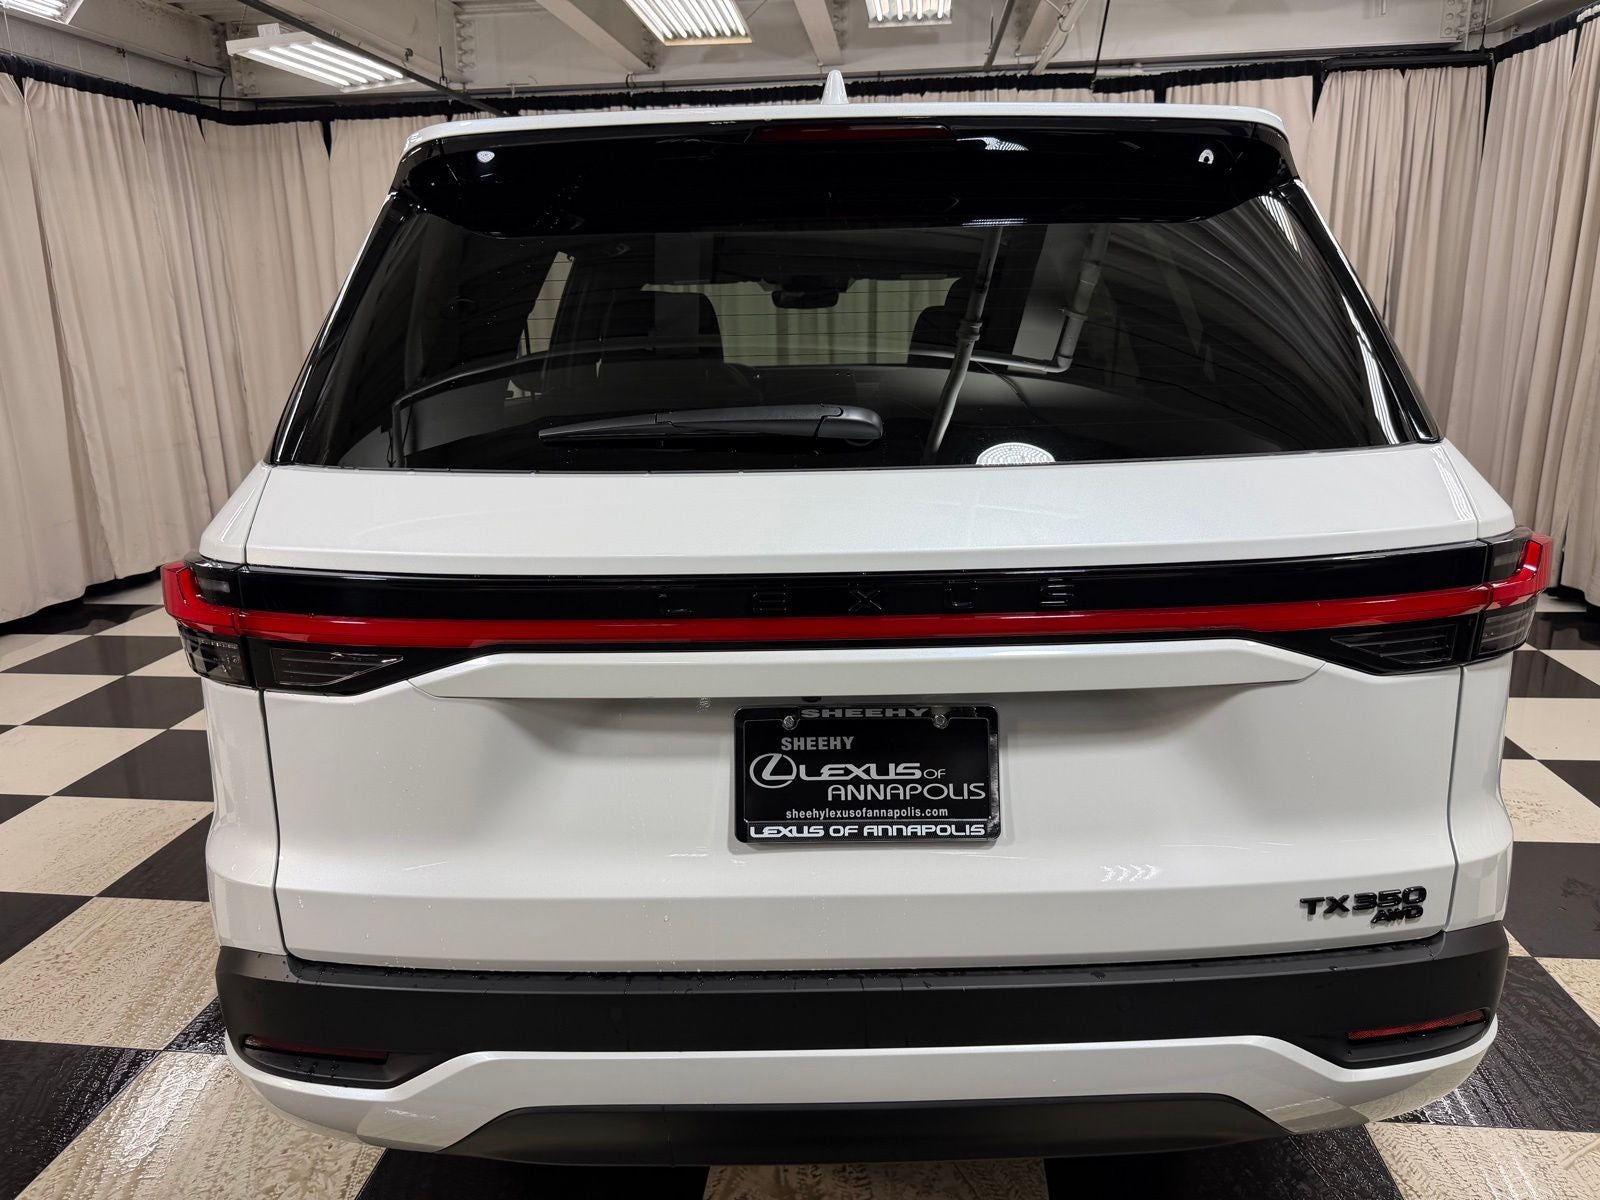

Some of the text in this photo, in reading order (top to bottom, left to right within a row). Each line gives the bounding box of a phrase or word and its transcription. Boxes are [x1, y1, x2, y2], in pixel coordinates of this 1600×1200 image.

[801, 708, 929, 718] SHEEHY
[781, 736, 854, 751] SHEEHY
[800, 763, 946, 780] LEXUS OF
[828, 783, 986, 801] ANNAPOLIS
[786, 807, 948, 820] sheehylexusofannapolis.com
[750, 824, 985, 838] LEXUS OF ANNAPOLIS
